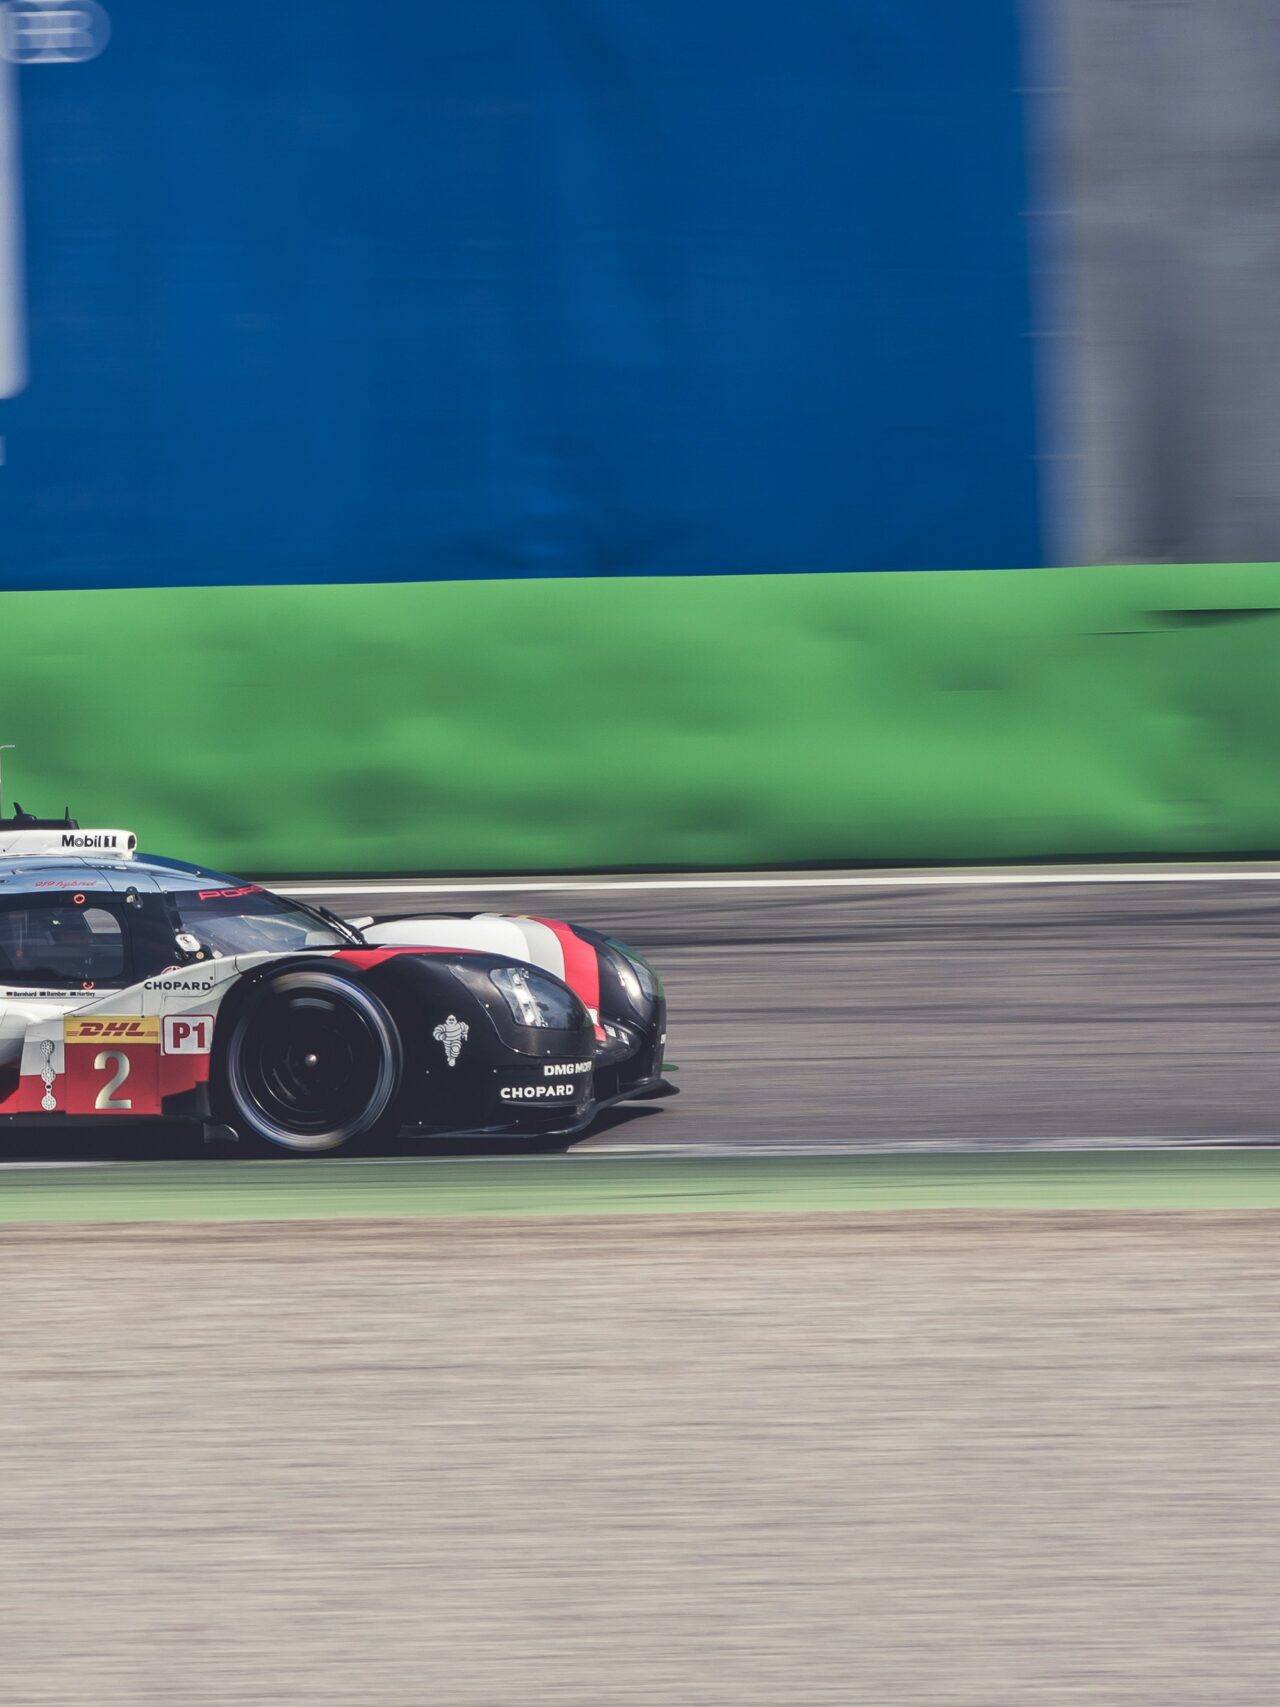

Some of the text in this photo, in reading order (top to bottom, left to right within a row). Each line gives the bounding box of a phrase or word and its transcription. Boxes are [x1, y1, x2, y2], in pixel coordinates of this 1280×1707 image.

[61, 834, 102, 848] Mobil
[144, 981, 212, 991] CHOPARD
[79, 1022, 146, 1037] DHL
[172, 1022, 206, 1049] P1
[543, 1064, 574, 1077] DMG
[93, 1050, 132, 1109] 2
[500, 1085, 575, 1099] CHOPARD
